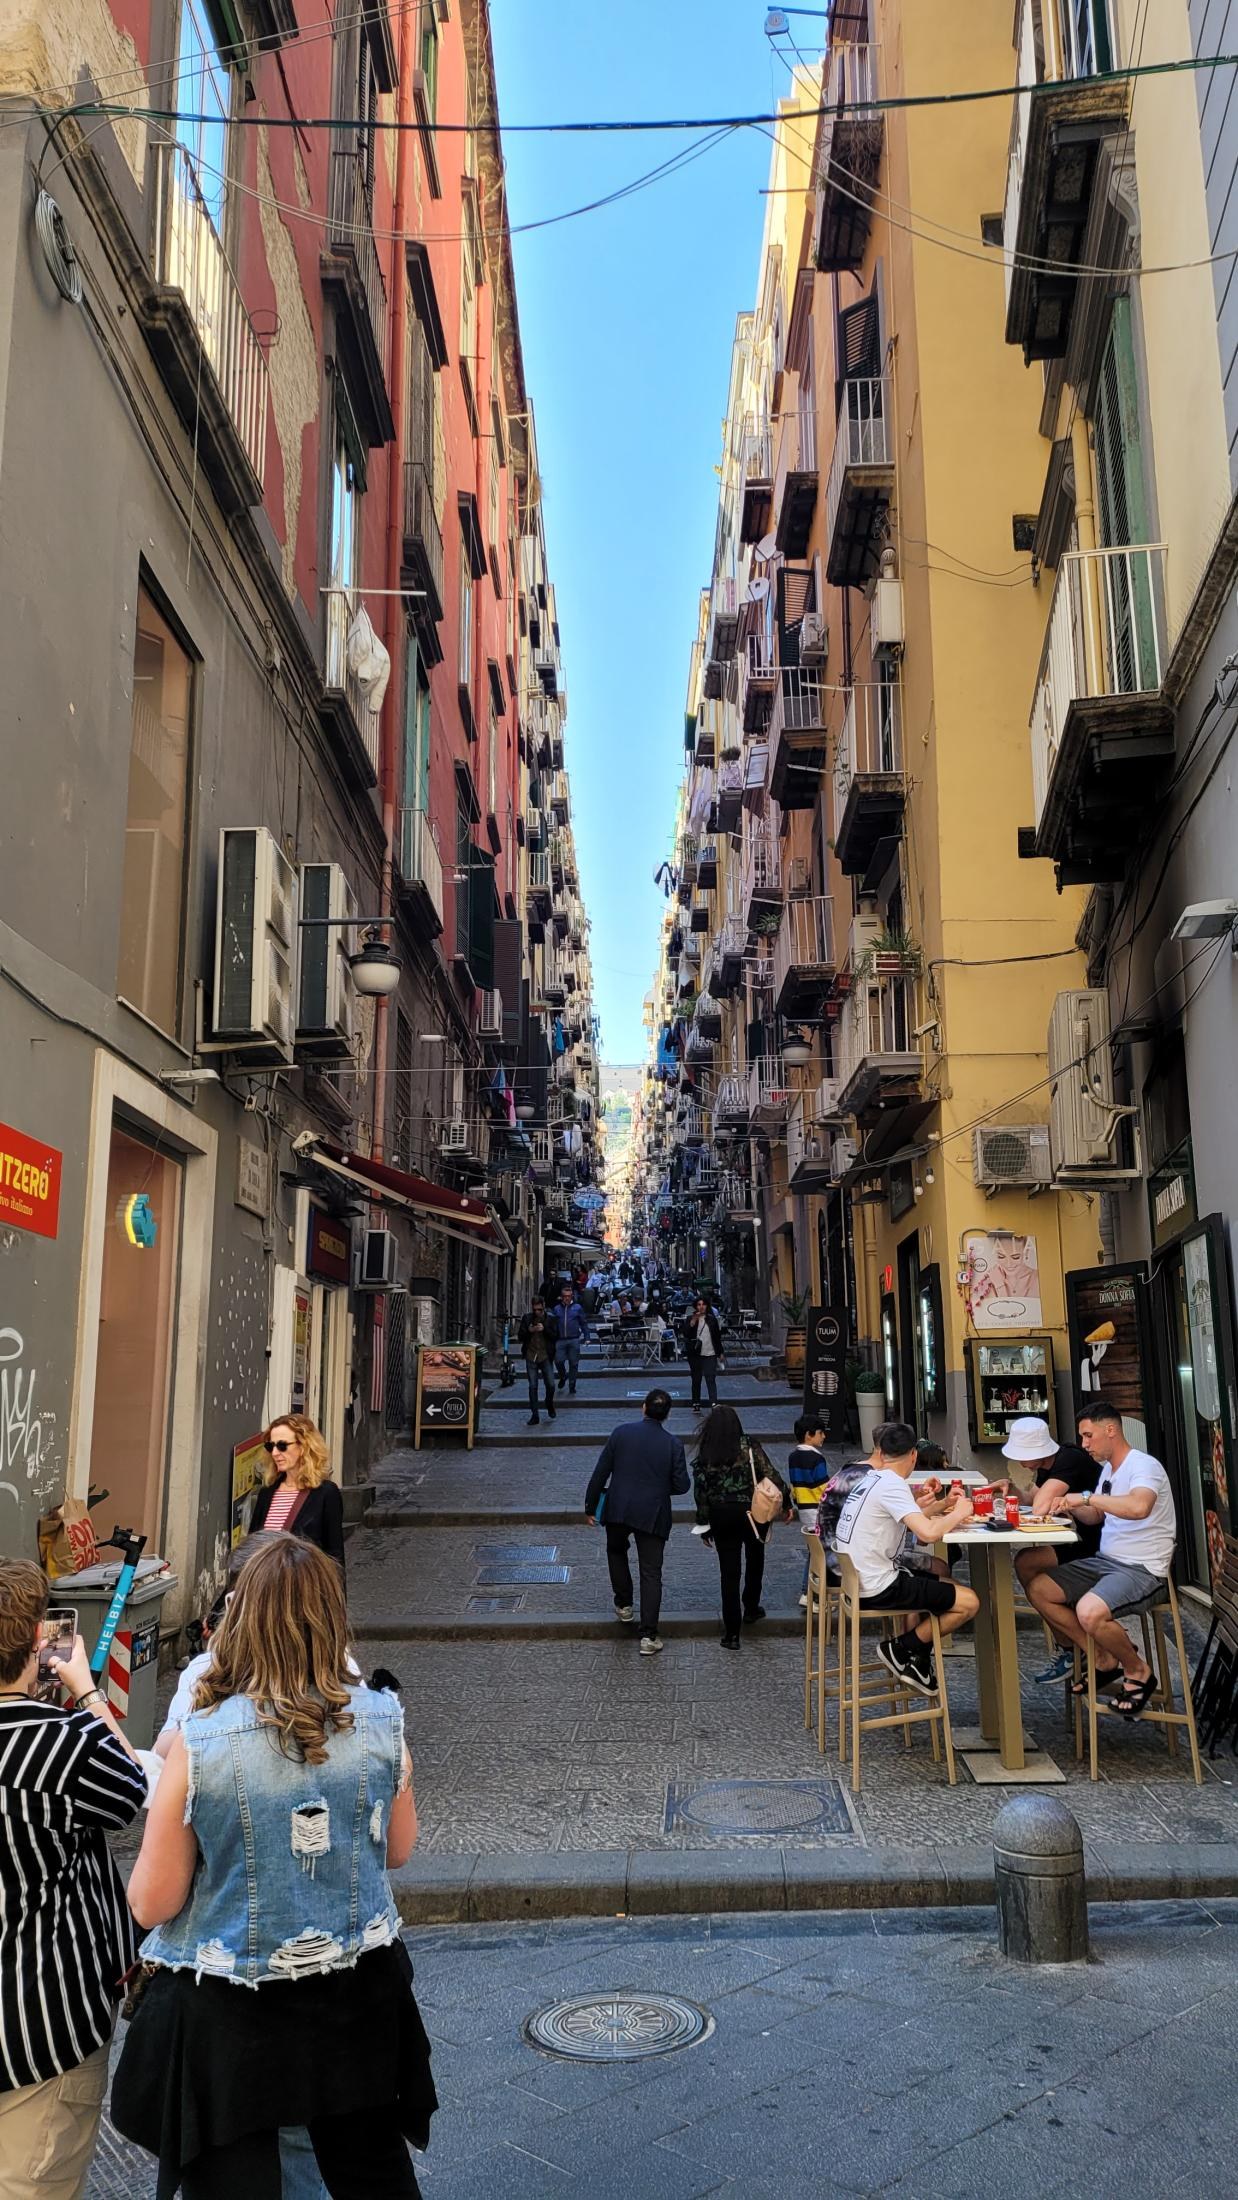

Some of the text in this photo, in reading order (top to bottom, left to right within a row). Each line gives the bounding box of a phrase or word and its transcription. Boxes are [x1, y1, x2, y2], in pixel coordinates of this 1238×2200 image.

[1099, 1289, 1136, 1304] DONNA SOFIA
[818, 1326, 837, 1336] TUUM
[98, 1593, 126, 1651] HELBIZ
